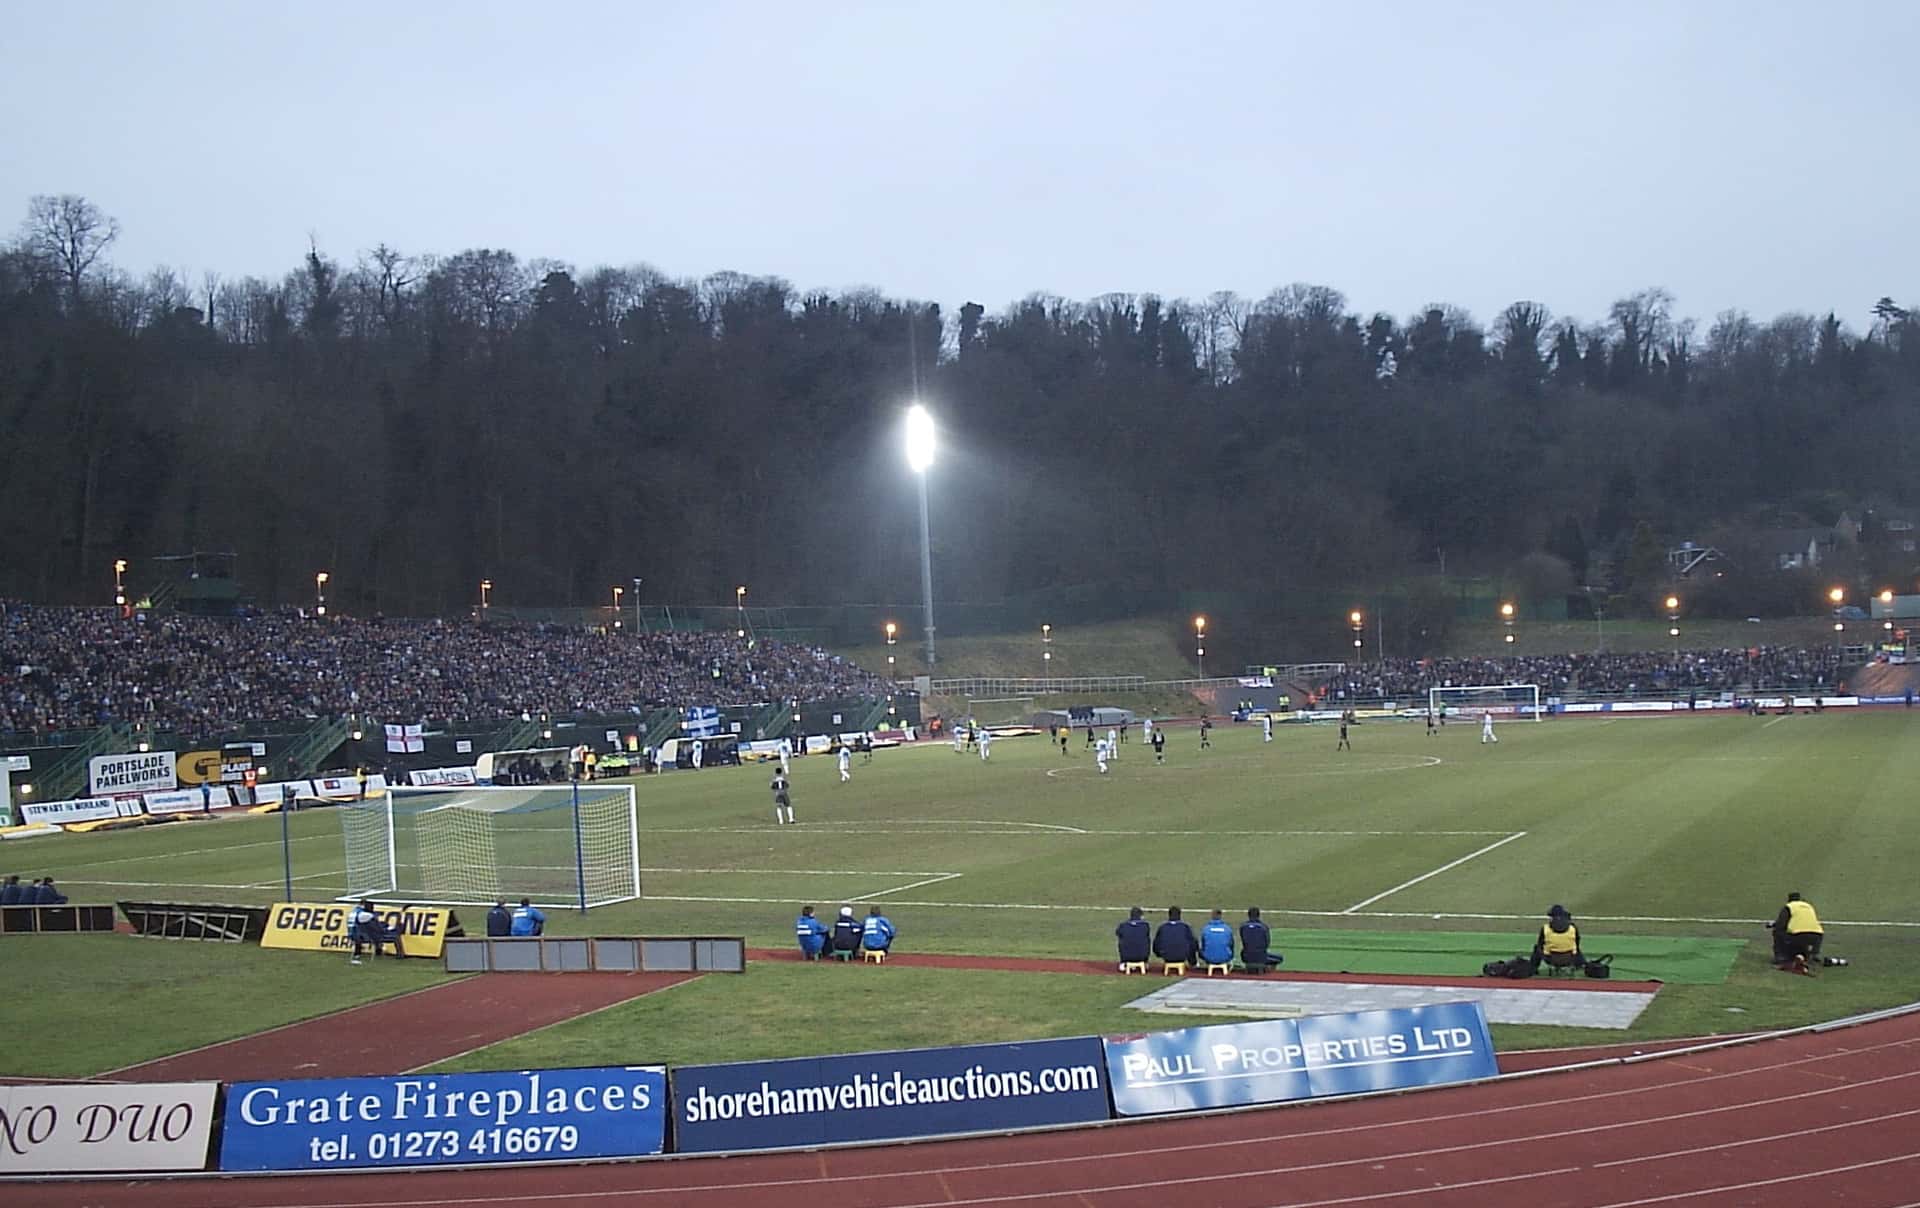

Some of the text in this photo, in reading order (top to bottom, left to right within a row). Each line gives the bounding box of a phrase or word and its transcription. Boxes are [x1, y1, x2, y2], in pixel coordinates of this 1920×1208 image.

[96, 766, 170, 789] PANELWORKS
[101, 756, 164, 775] PORTSLADE
[276, 907, 344, 931] GREG
[1122, 1026, 1473, 1080] PAUL PROPERTIES LTD
[240, 1073, 651, 1126] Grate Fireplaces
[686, 1065, 1099, 1123] shorehamvehicleauctions.com
[76, 1102, 194, 1143] DUO
[309, 1124, 579, 1162] tel. 01273 416679
